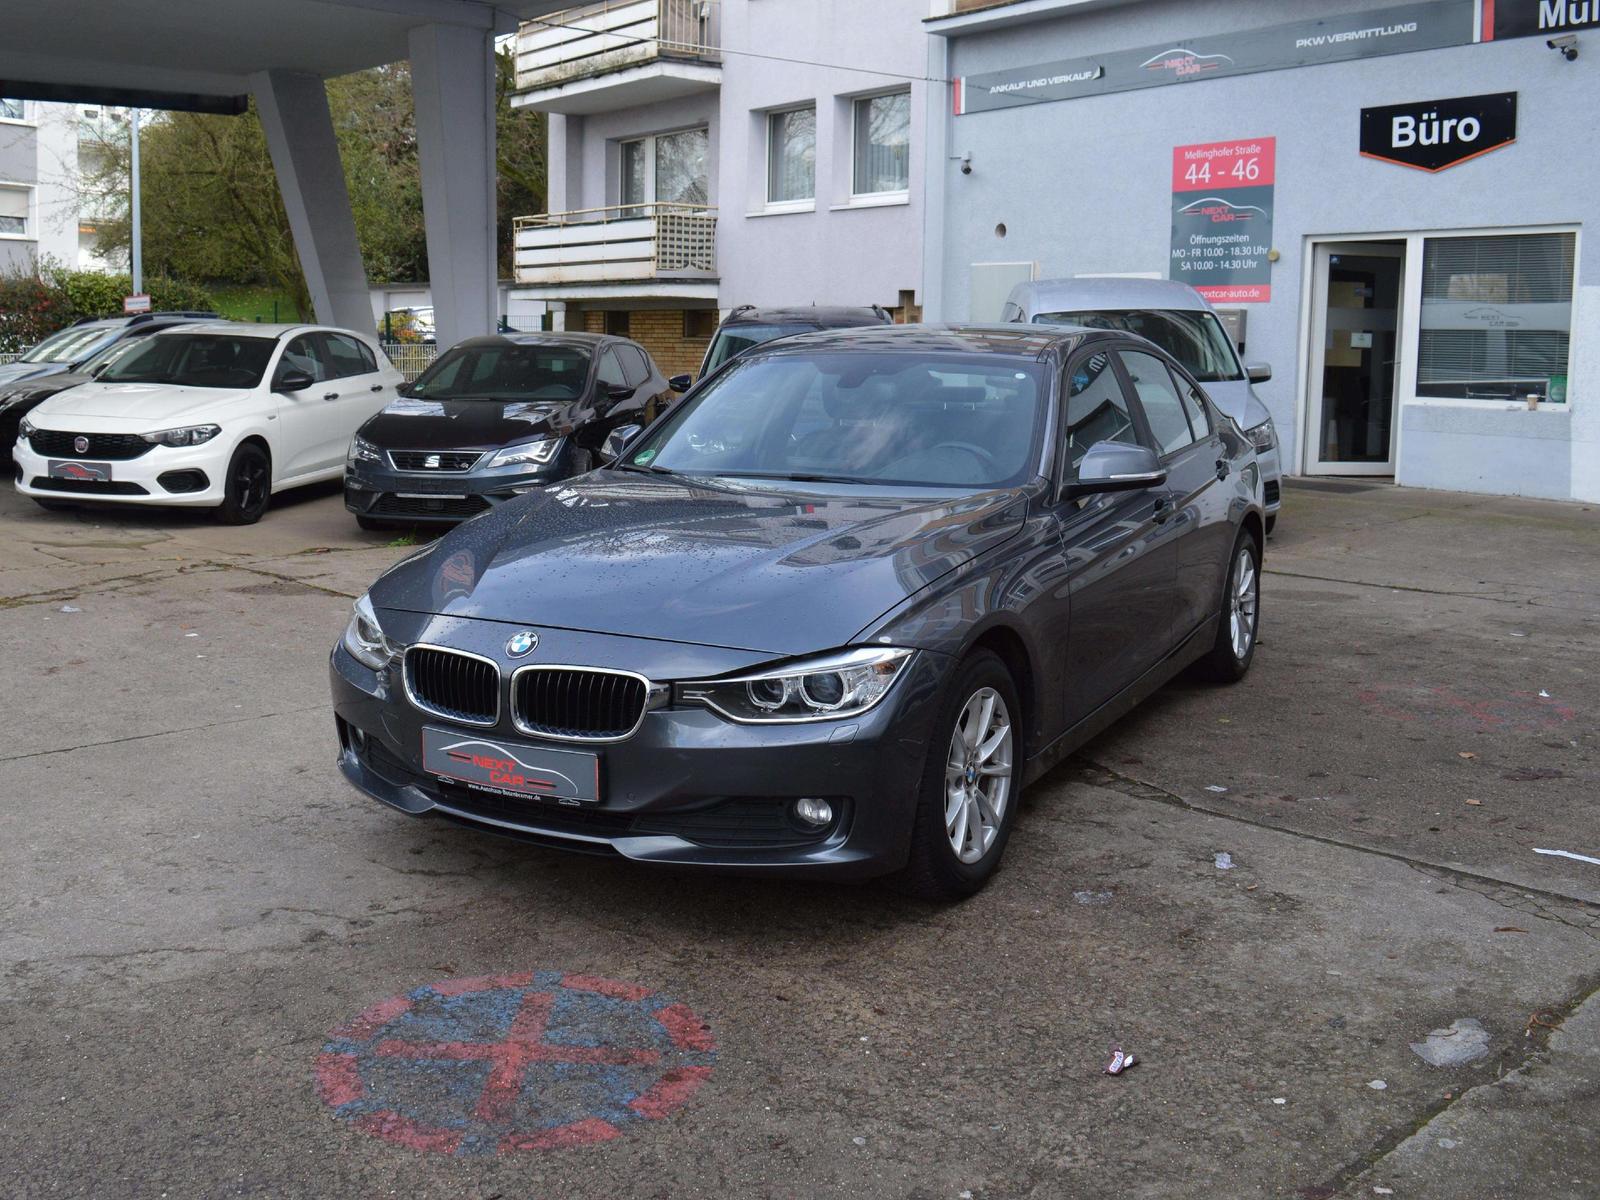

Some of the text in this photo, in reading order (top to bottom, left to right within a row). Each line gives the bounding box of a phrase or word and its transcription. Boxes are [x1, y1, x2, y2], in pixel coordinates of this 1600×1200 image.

[1296, 22, 1417, 48] PKW VERMITTLUNG
[1164, 56, 1196, 68] NEXT
[1176, 64, 1201, 75] CAR
[989, 71, 1092, 94] ANKAUF UND VERKAUF
[1391, 112, 1481, 148] Büro
[1184, 144, 1262, 160] Mellinghofer Straße
[1185, 161, 1211, 185] 44
[1232, 157, 1259, 181] 46
[1201, 206, 1229, 215] NEXT
[1211, 213, 1235, 223] CAR
[1190, 233, 1250, 246] Öffnungszeiten
[1172, 248, 1186, 258] MO
[1191, 248, 1202, 257] FR
[1203, 247, 1223, 257] 10.00
[1231, 246, 1252, 256] 18.30
[1253, 245, 1268, 255] Uhr
[1181, 261, 1191, 271] SA
[1193, 261, 1214, 270] 10.00
[1220, 260, 1241, 269] 14.30
[1242, 259, 1258, 269] Uhr
[472, 754, 518, 772] NEXT
[488, 769, 525, 787] CAR
